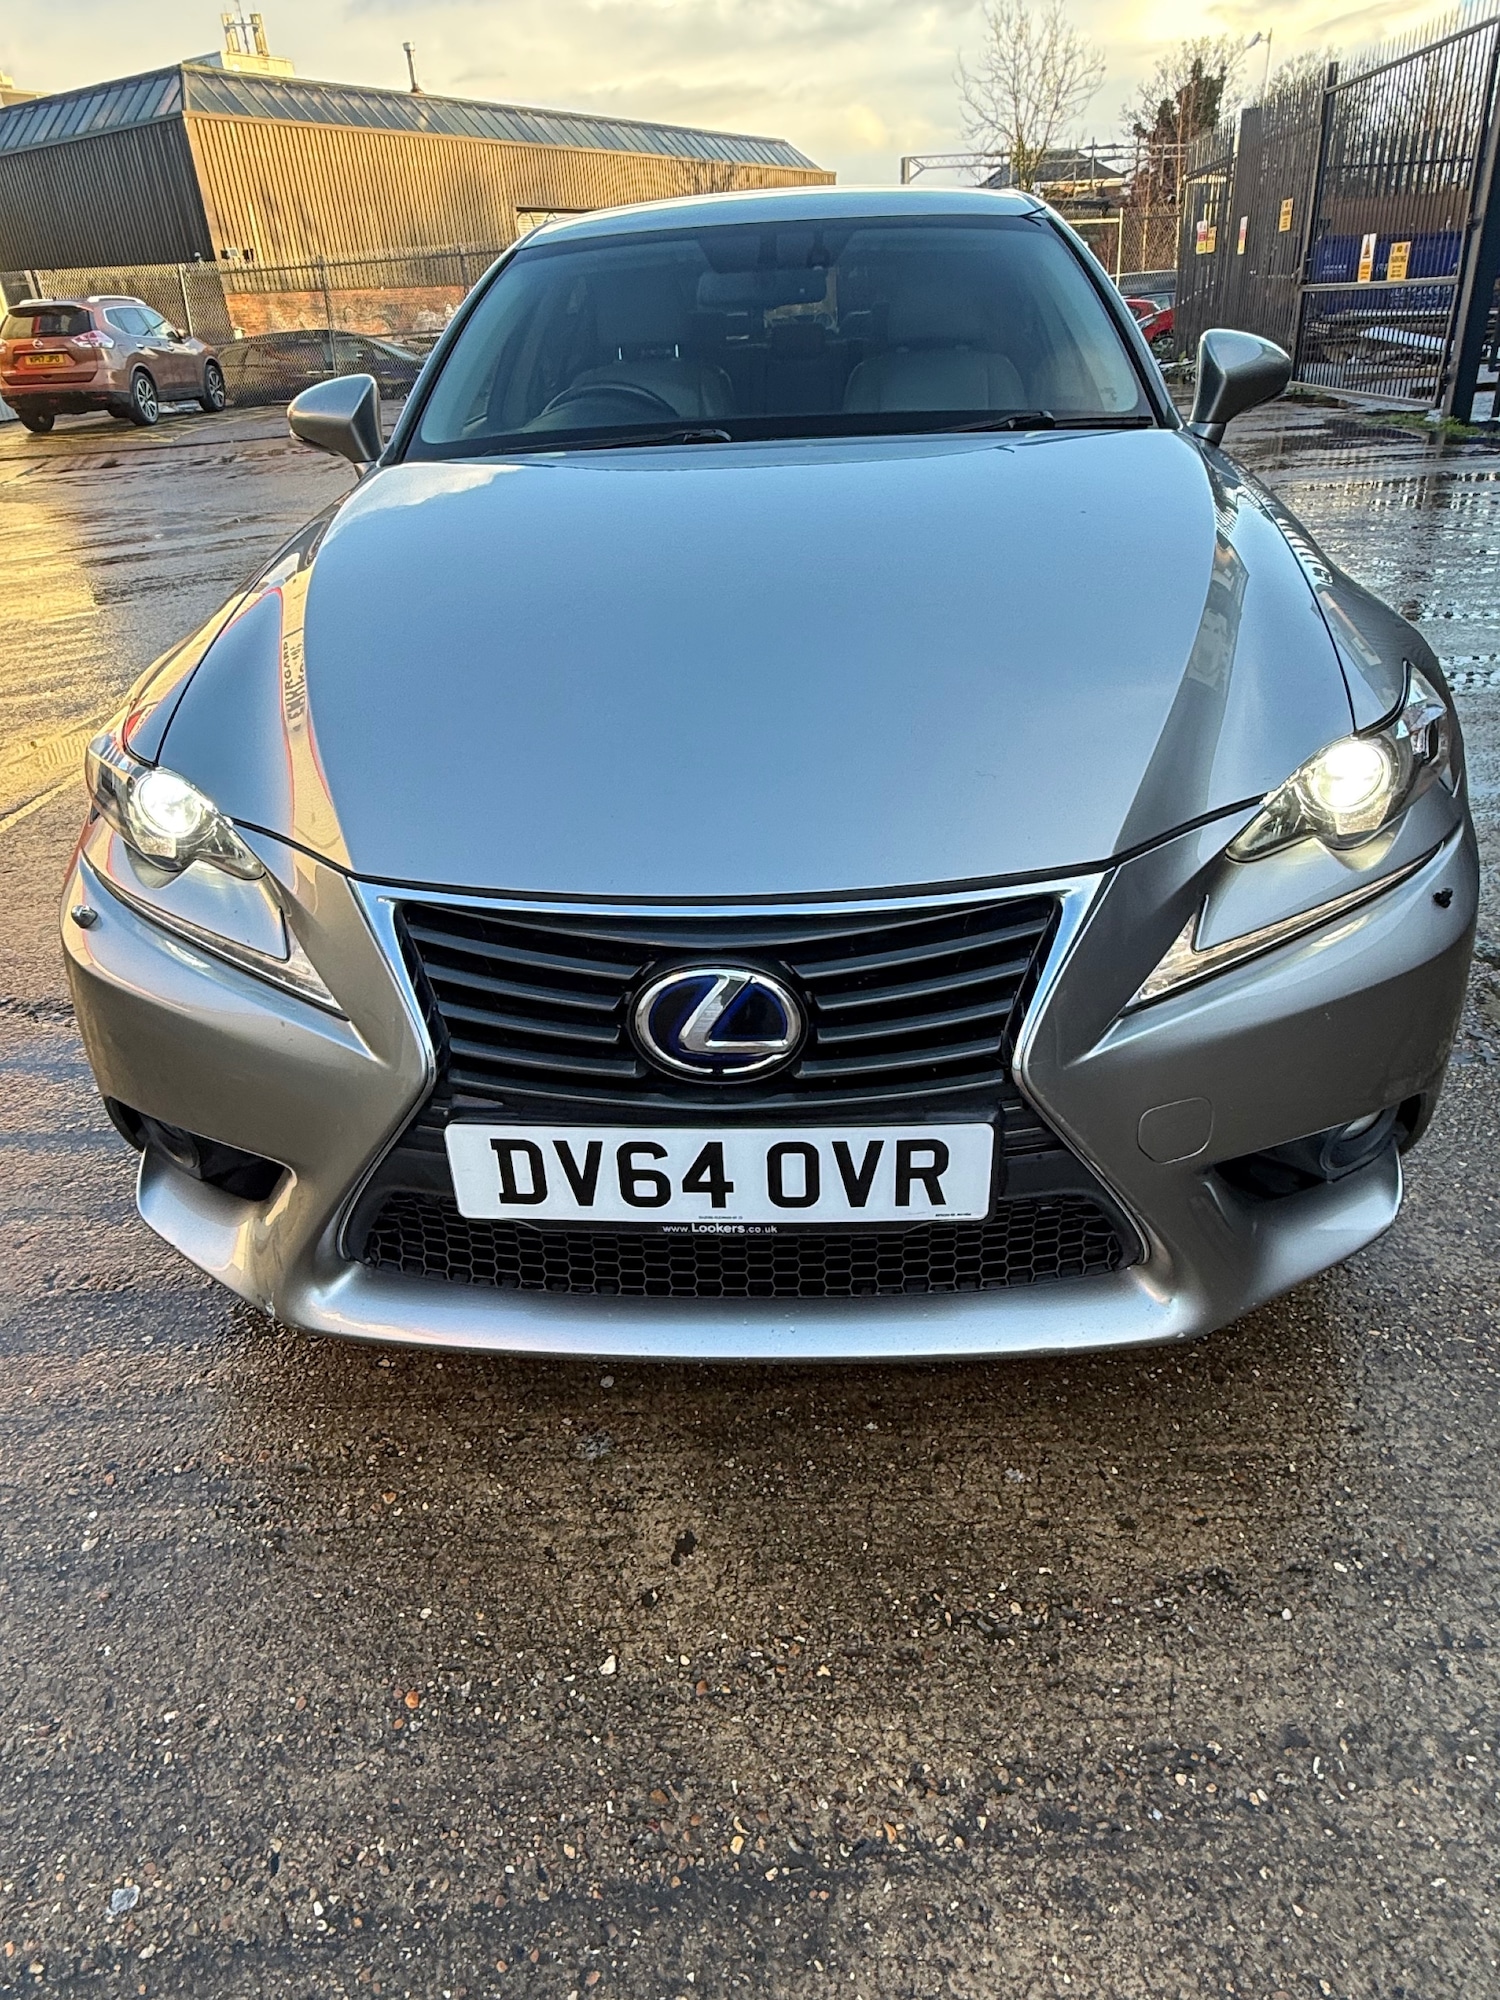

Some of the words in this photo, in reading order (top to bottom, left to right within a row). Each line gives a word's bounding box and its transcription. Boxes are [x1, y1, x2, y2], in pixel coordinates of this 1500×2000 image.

[489, 1138, 734, 1209] DV64
[766, 1138, 949, 1208] OVR
[662, 1222, 778, 1233] www.Lookers.co.uk
